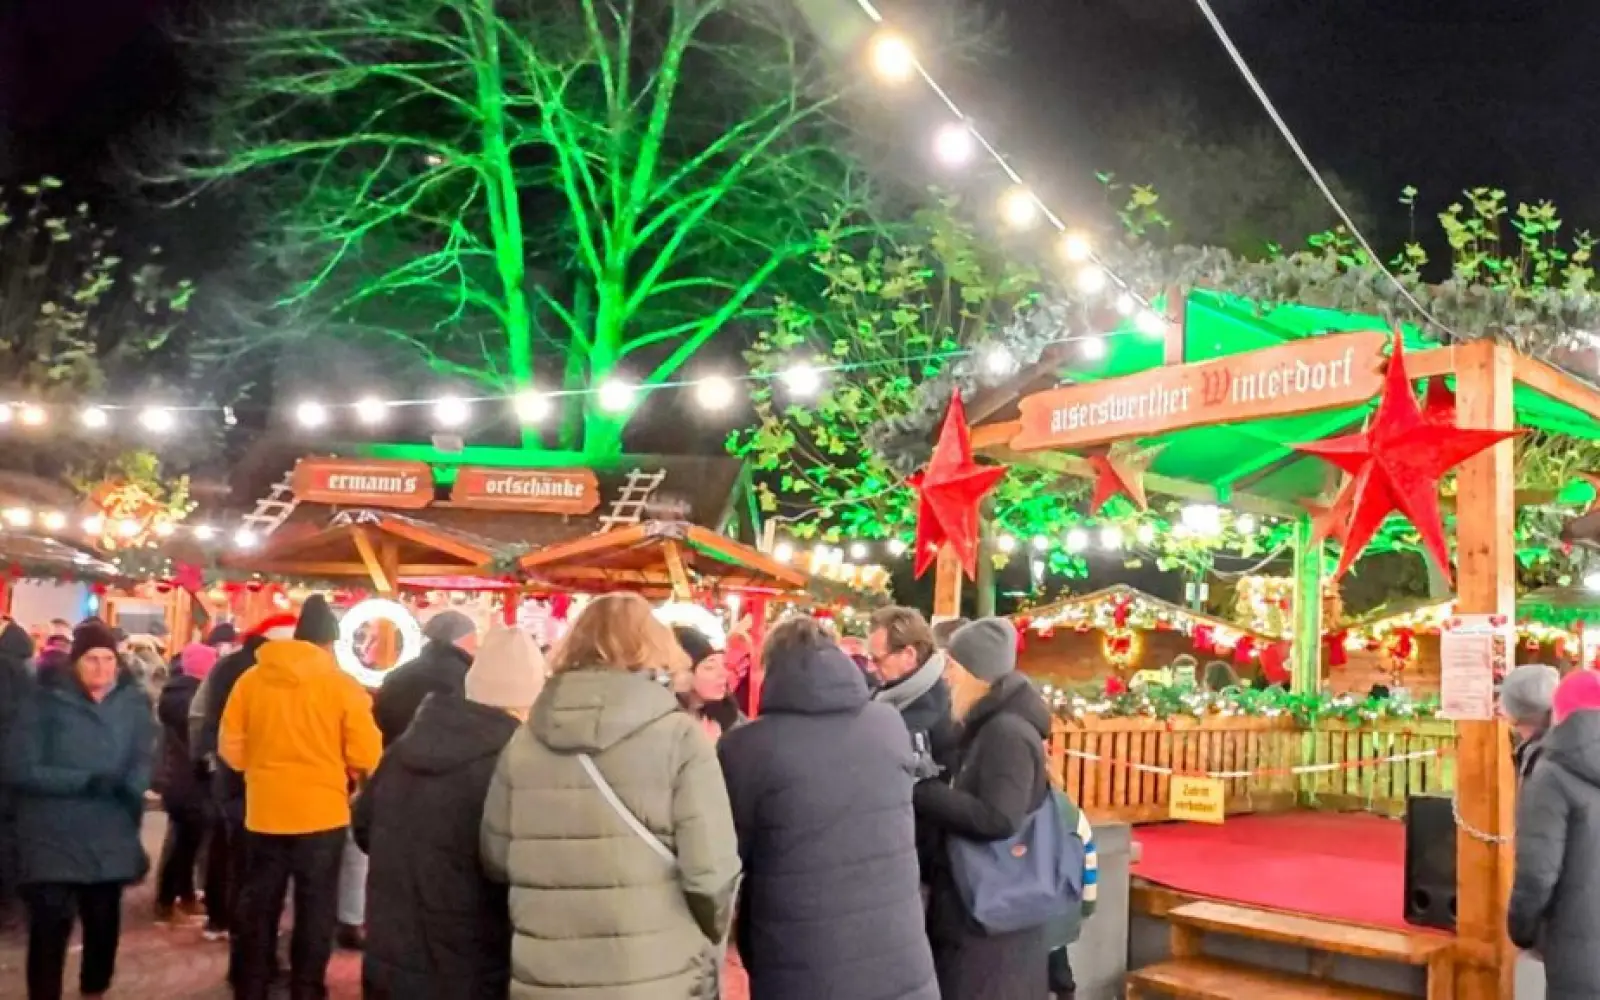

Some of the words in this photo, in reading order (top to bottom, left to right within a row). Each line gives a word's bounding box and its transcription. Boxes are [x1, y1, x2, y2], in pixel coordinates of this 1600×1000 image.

[1035, 384, 1193, 435] aiserswerther
[1200, 346, 1355, 406] Winterdorf
[314, 471, 418, 494] ermann's
[467, 475, 585, 498] orfschänke
